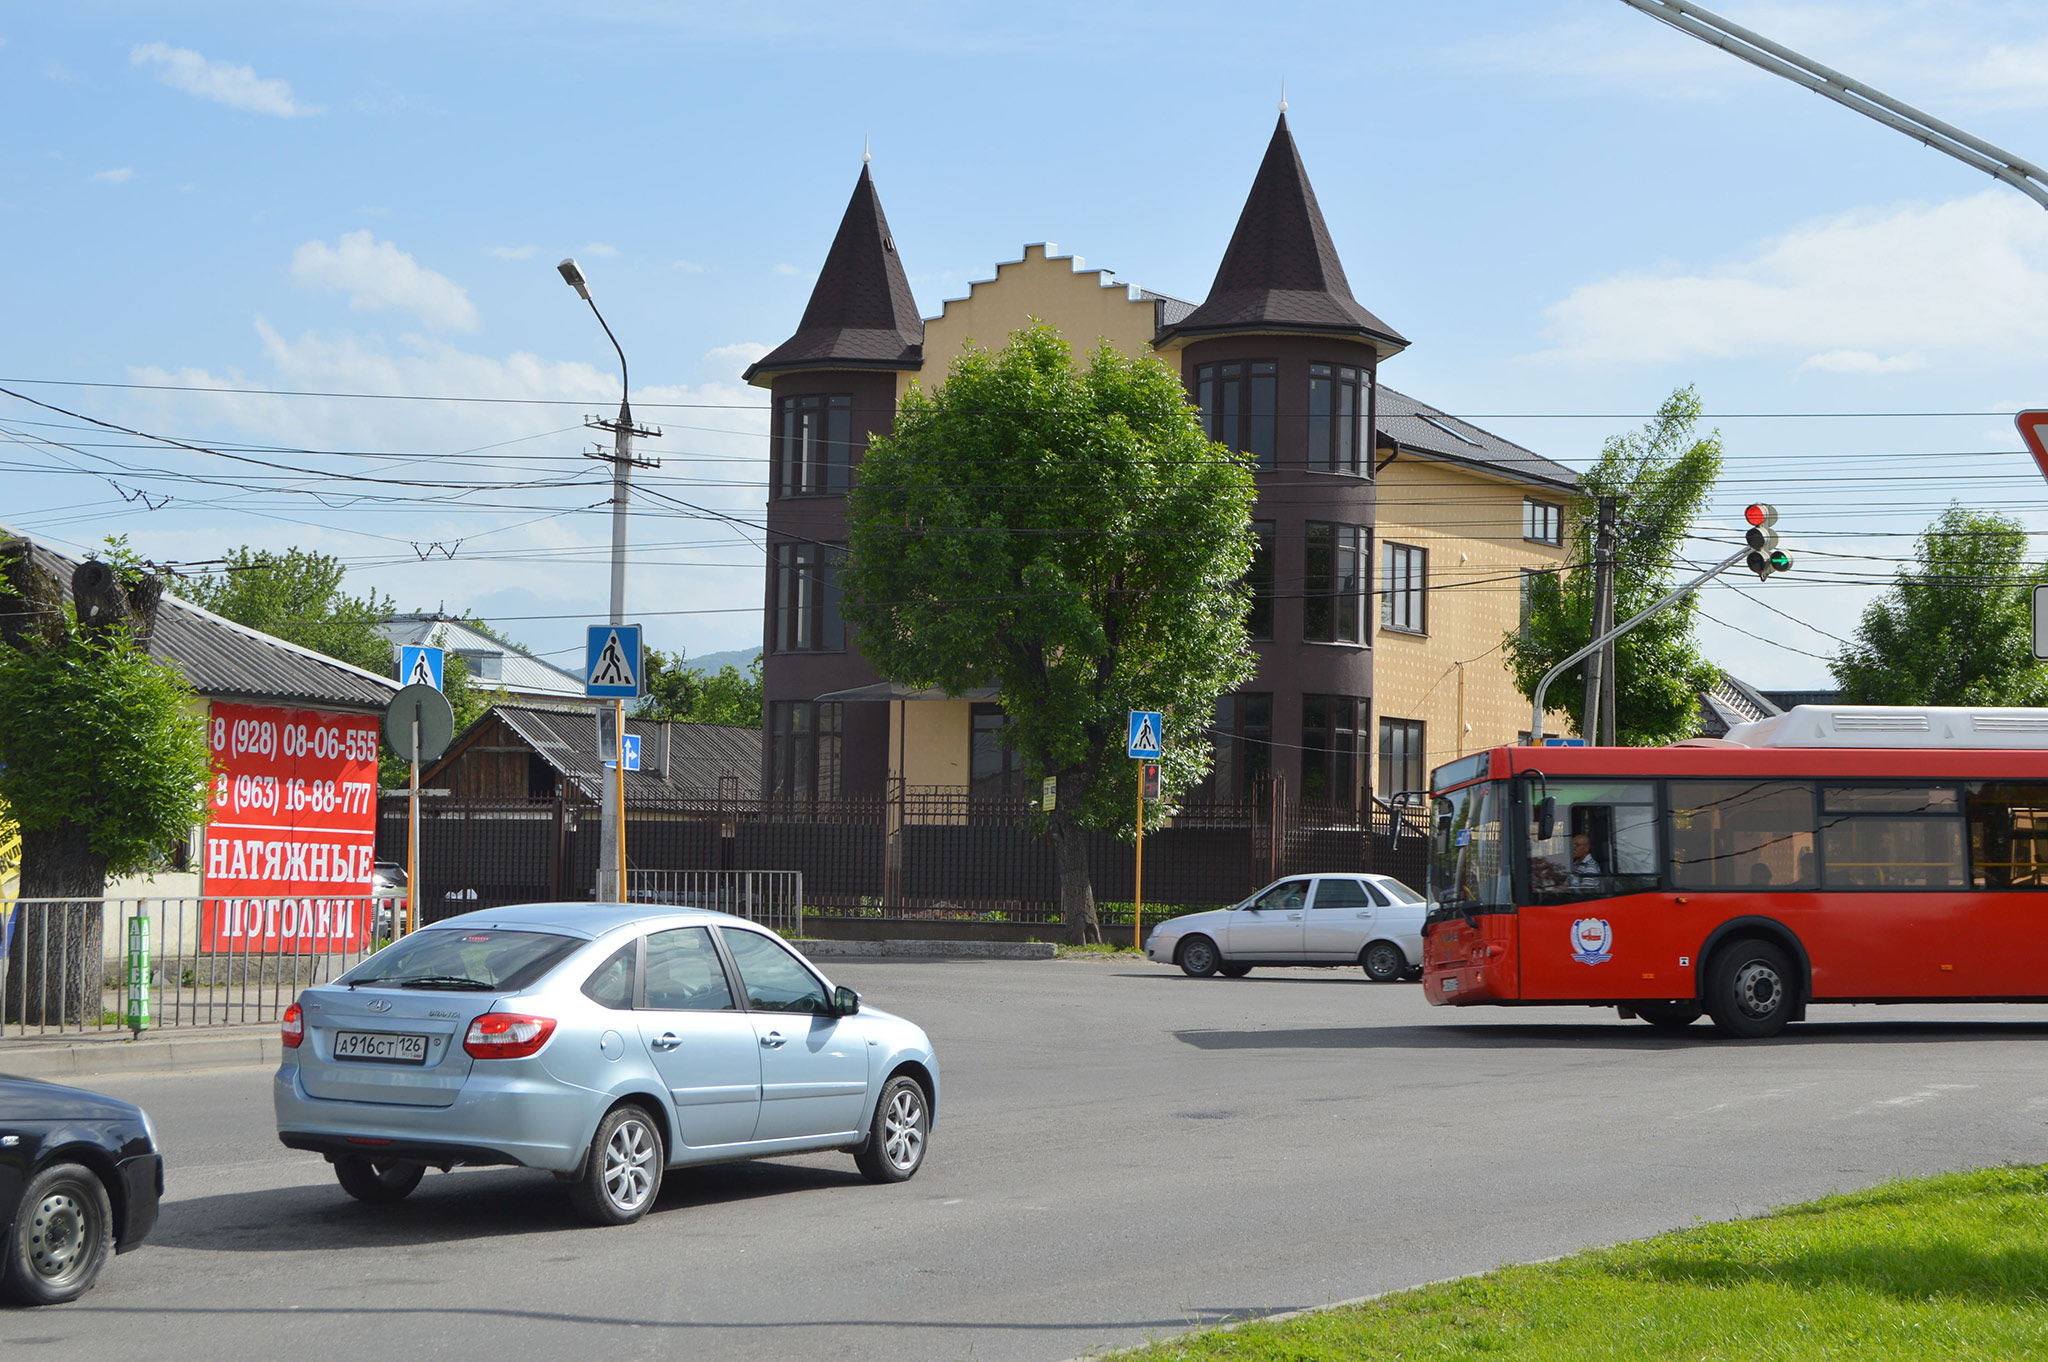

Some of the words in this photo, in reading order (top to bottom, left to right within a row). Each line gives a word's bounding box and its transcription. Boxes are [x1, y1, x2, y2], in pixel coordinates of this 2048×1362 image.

[213, 717, 226, 751] 8
[231, 719, 278, 762] (928)
[283, 723, 377, 762] 08-06-555
[215, 773, 228, 807] 8
[234, 774, 280, 817] (963)
[285, 777, 371, 815] 16-88-777
[207, 838, 373, 883] НАТЯЖНЫЕ
[222, 898, 354, 938] ПОТОЛКИ
[128, 919, 141, 1017] АПТЕКА
[141, 919, 150, 1017] АПТЕКА
[398, 1037, 421, 1052] 126
